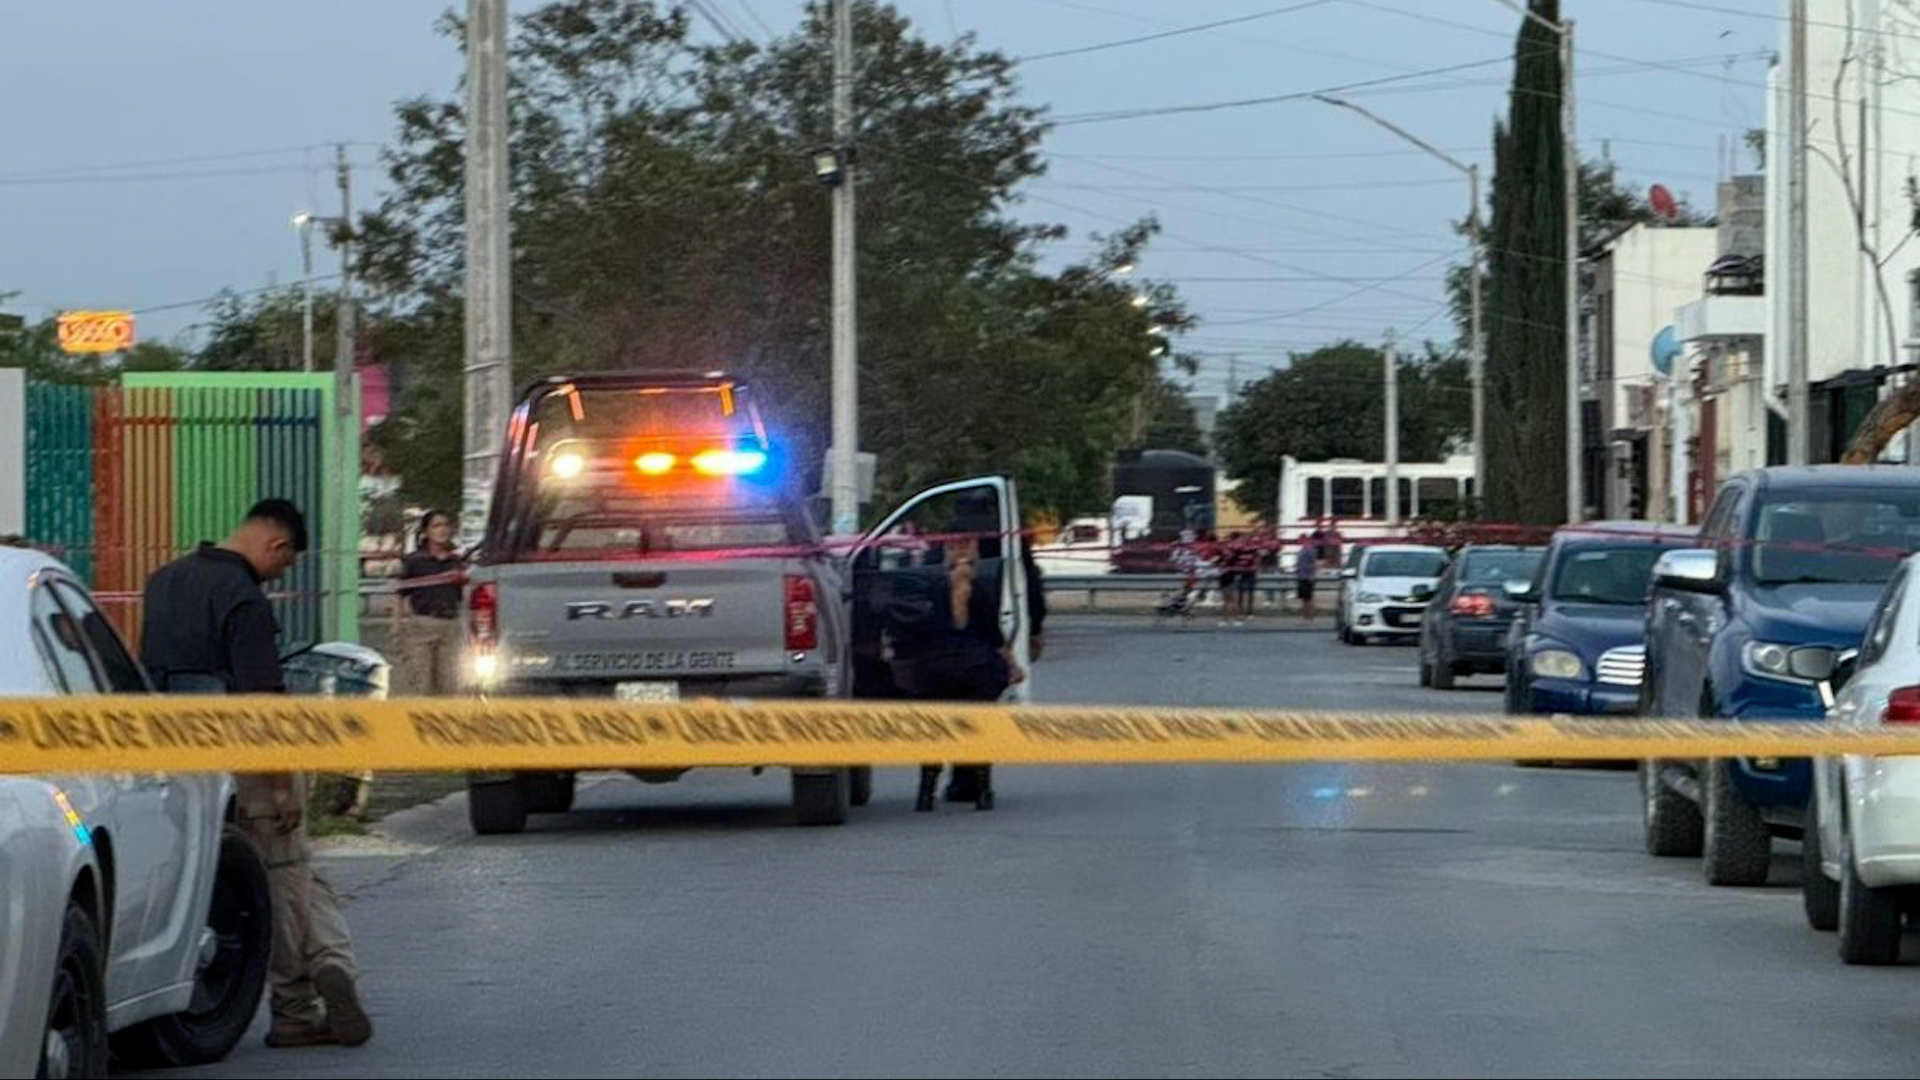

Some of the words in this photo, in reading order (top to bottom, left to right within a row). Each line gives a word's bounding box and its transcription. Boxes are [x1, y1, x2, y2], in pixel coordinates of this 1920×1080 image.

[566, 599, 714, 620] RAM
[575, 652, 641, 669] SERVICIO
[645, 652, 664, 669] DE
[668, 652, 684, 668] LA
[689, 651, 736, 668] GENTE
[102, 710, 149, 748] DE
[539, 711, 581, 746] EL
[572, 710, 649, 747] PASO
[740, 710, 785, 743] DE
